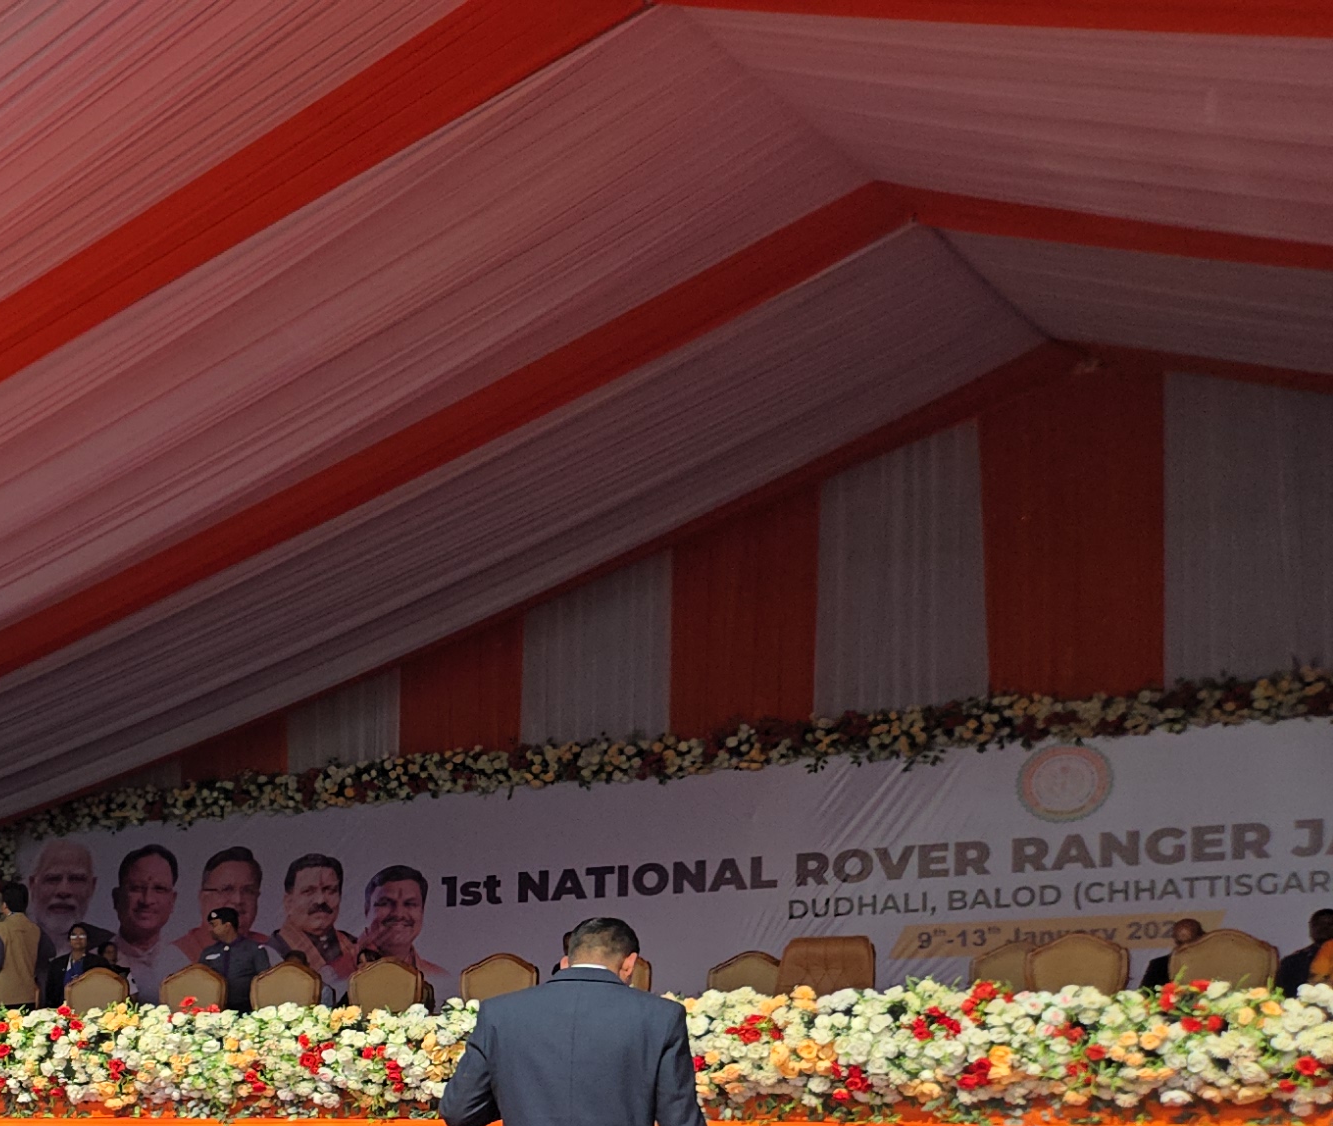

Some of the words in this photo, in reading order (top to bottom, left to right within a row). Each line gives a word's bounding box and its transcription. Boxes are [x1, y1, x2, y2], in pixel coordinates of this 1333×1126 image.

[441, 874, 502, 908] 1st
[516, 855, 778, 903] NATIONAL
[795, 841, 991, 888] ROVER
[1010, 822, 1271, 874] RANGER
[788, 890, 937, 921] DUDHALI,
[946, 882, 1061, 911] BALOD
[1073, 869, 1331, 910] (CHHATTISGAR
[1127, 921, 1177, 941] 202
